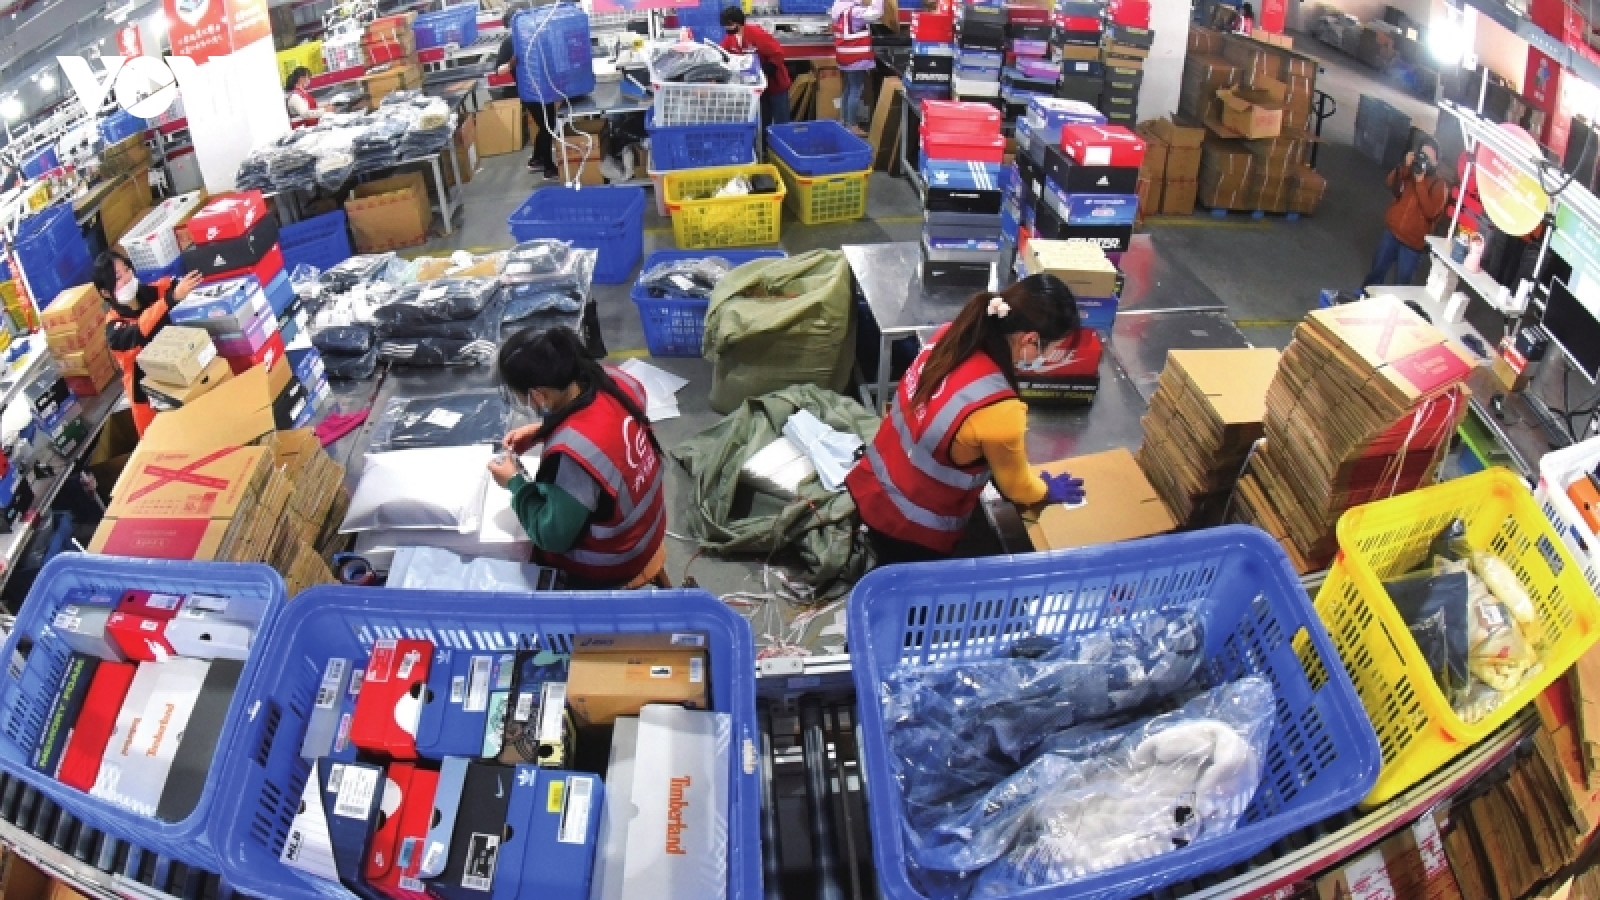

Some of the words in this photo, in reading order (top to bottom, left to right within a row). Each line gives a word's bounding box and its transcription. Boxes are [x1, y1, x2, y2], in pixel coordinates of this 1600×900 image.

[40, 703, 65, 768] MEMORY
[63, 658, 84, 701] FOAM
[666, 775, 692, 855] Timberland
